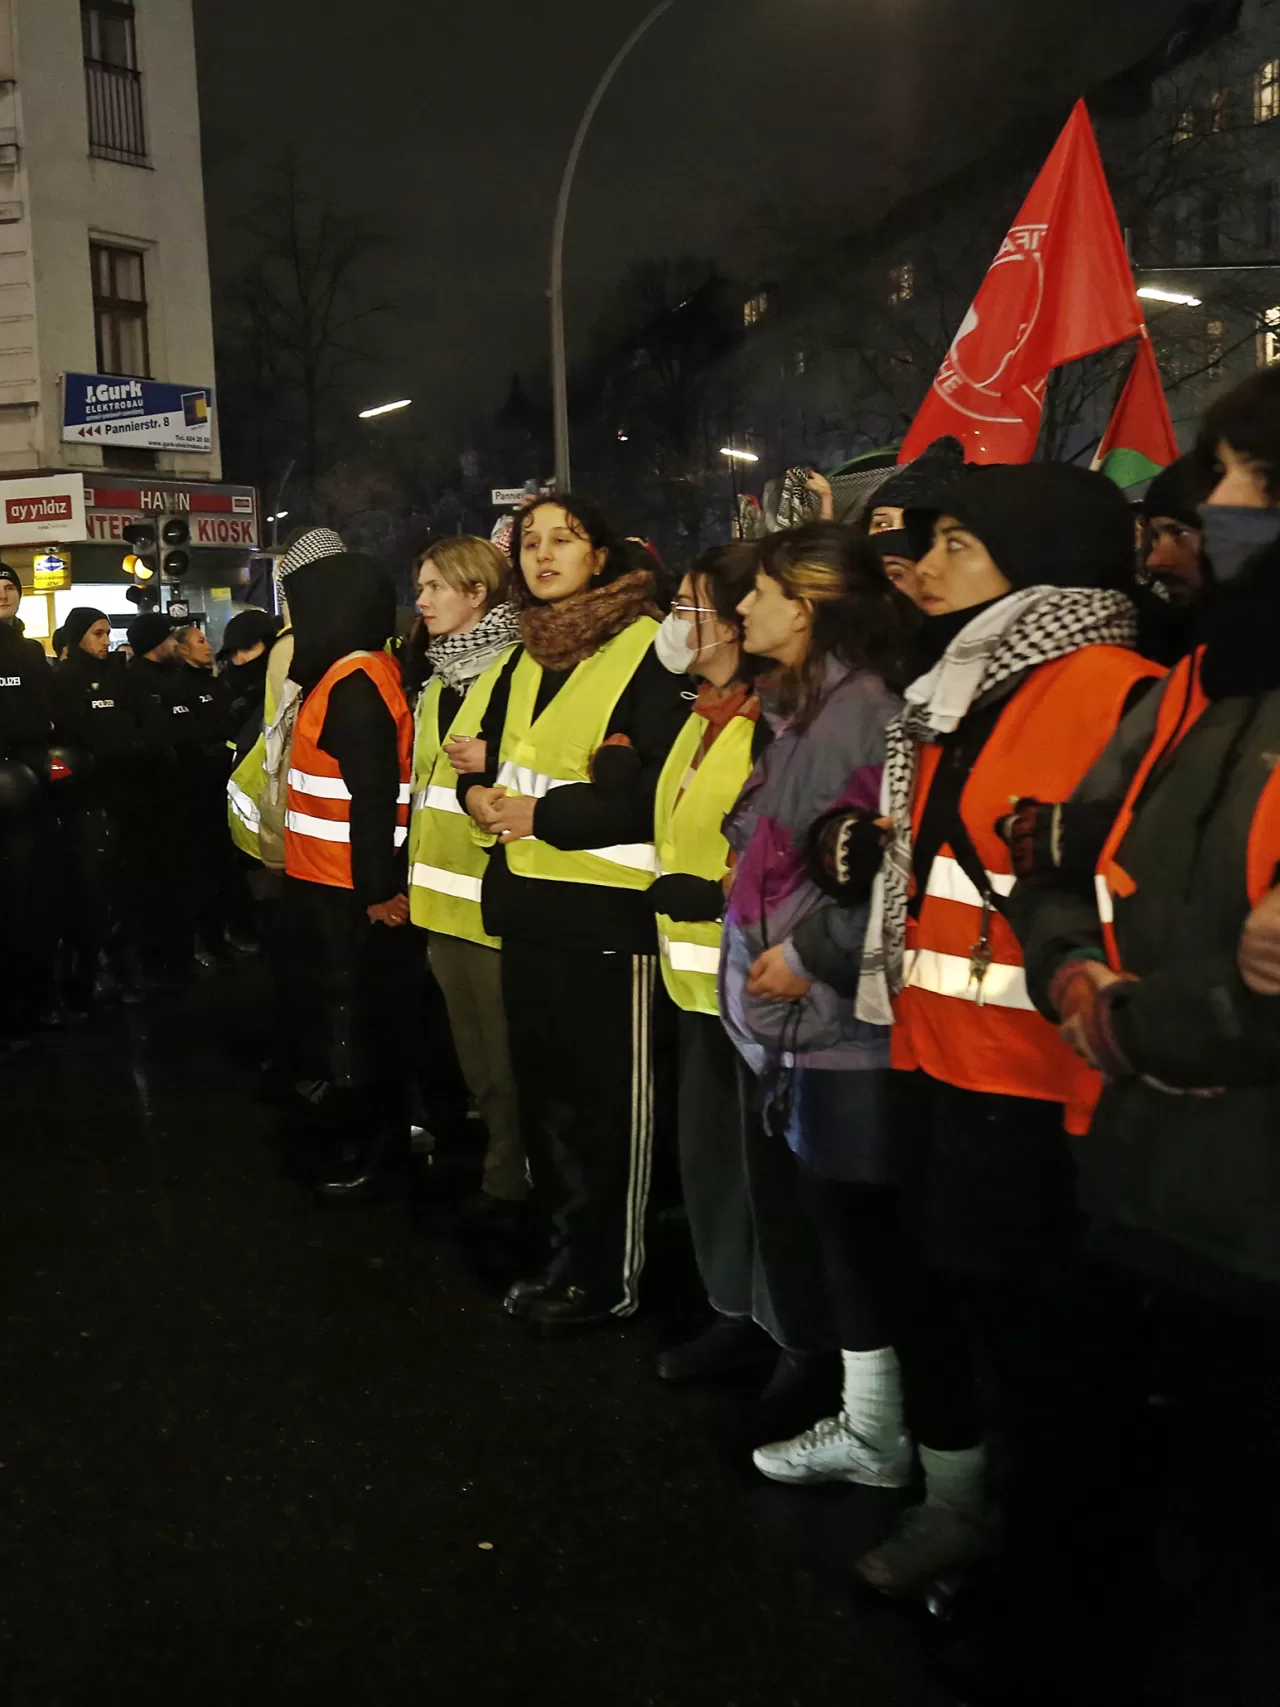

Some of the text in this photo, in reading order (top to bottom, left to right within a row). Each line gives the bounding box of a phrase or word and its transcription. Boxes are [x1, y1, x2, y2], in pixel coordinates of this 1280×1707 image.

[85, 381, 143, 403] J.Gurk
[85, 399, 144, 414] ELEKTROBAU
[105, 416, 170, 435] Pannierstr. 8
[11, 504, 28, 520] ay
[197, 519, 254, 543] KIOSK
